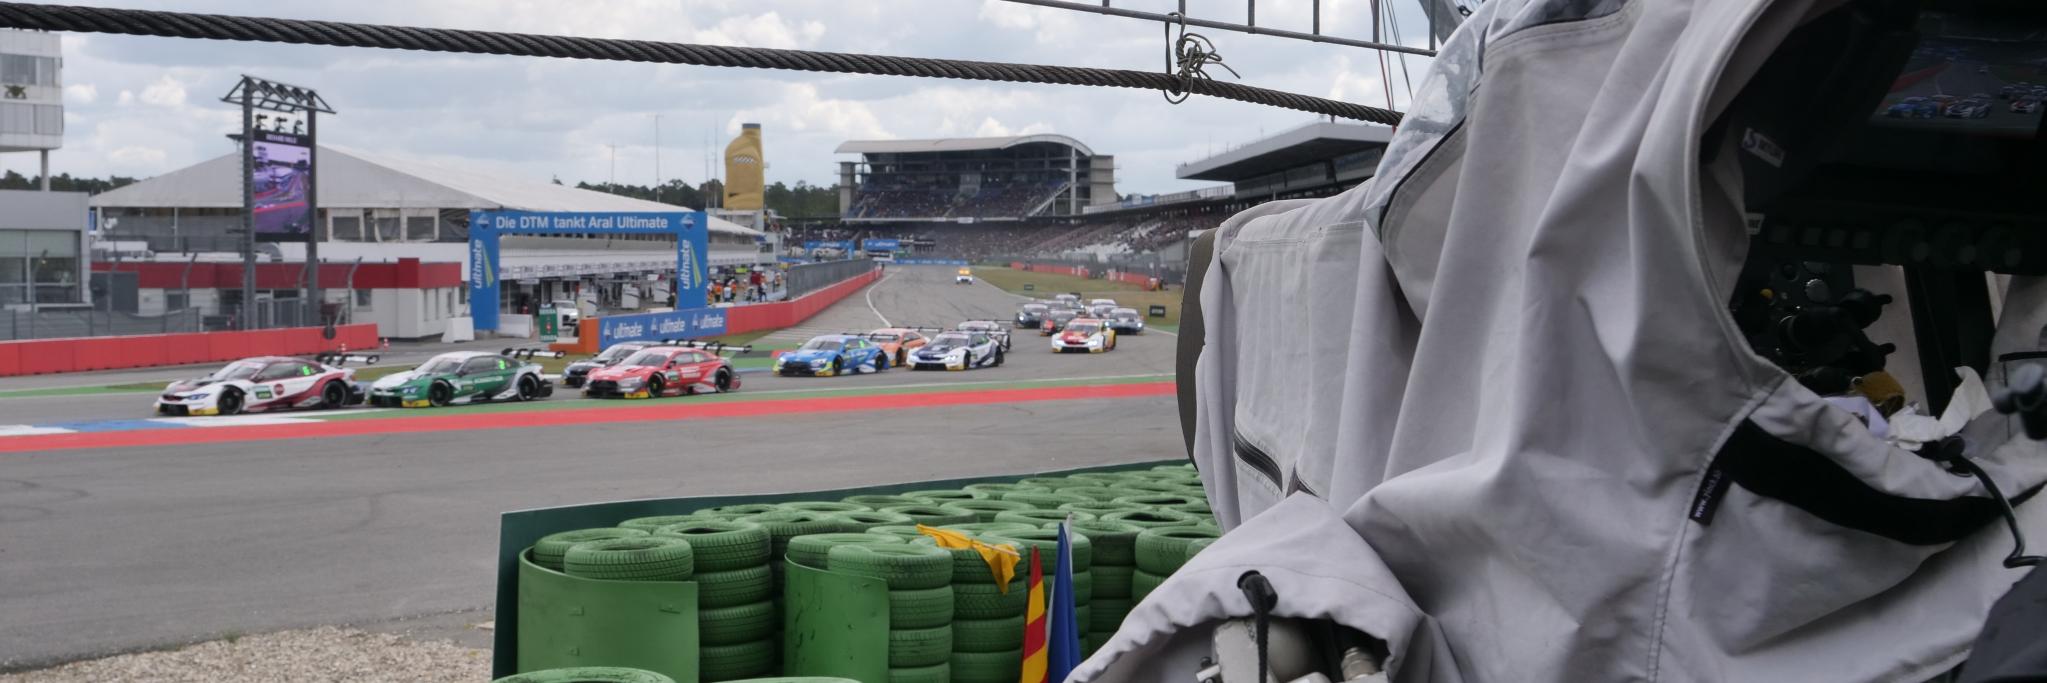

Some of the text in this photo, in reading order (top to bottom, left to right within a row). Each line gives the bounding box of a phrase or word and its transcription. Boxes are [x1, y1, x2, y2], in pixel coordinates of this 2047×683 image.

[495, 216, 668, 229] Die DTM tankt Aral Ultimate
[472, 239, 483, 289] ultimate
[682, 239, 691, 290] ultimate
[660, 317, 685, 334] ultimate
[700, 313, 724, 329] ultimate
[614, 322, 643, 339] ultimate
